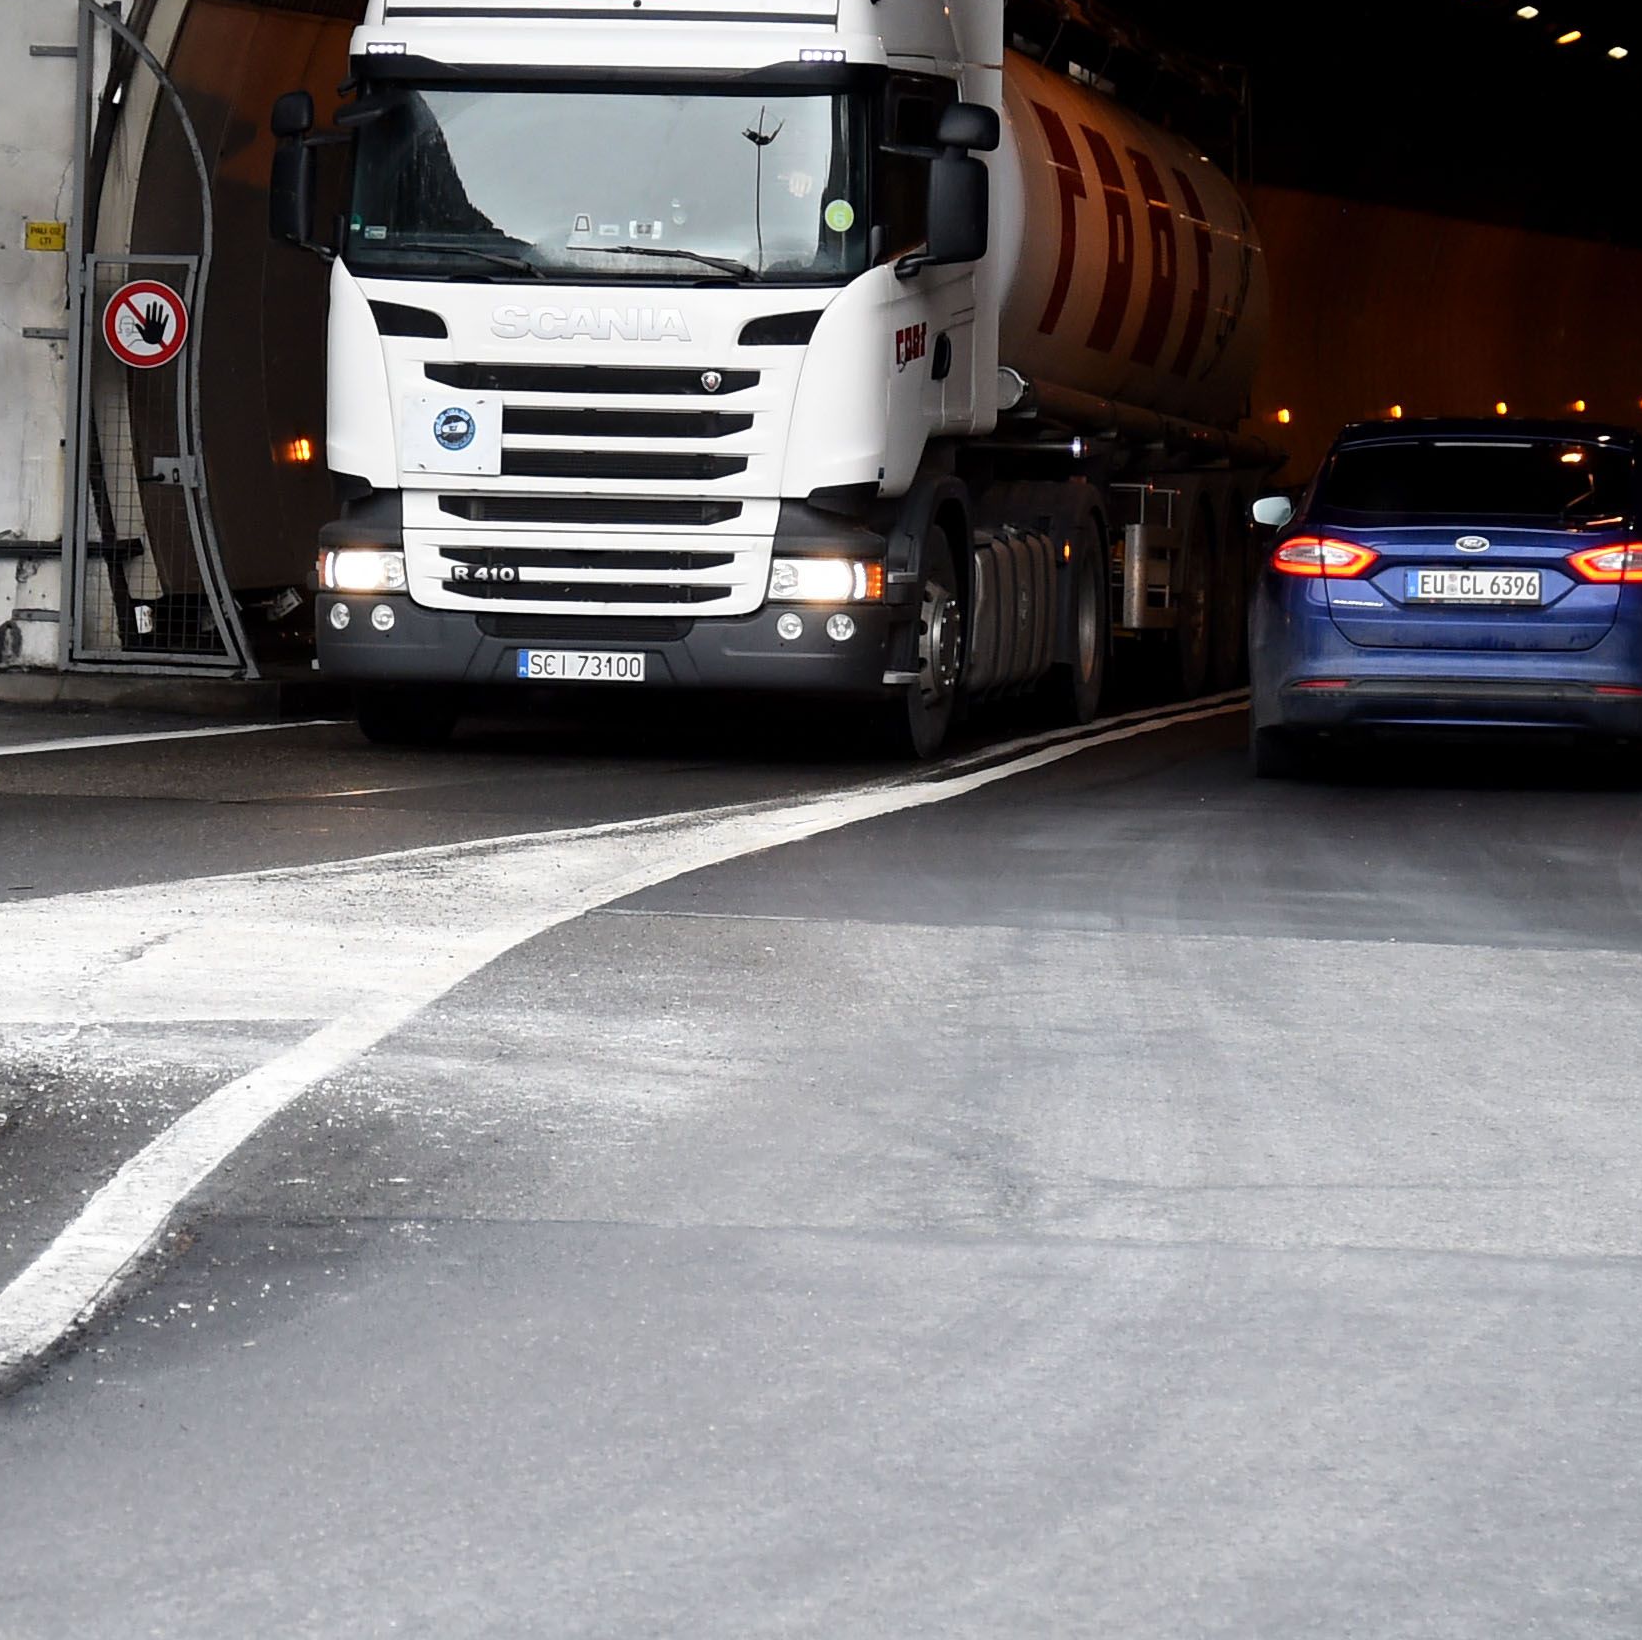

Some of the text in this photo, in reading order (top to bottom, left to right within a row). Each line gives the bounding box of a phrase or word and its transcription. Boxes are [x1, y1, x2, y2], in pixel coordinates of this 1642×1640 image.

[490, 305, 692, 342] SCANIA
[454, 566, 515, 581] R 410
[1420, 574, 1537, 596] EU CL 6396
[530, 654, 641, 678] SCI 73100
